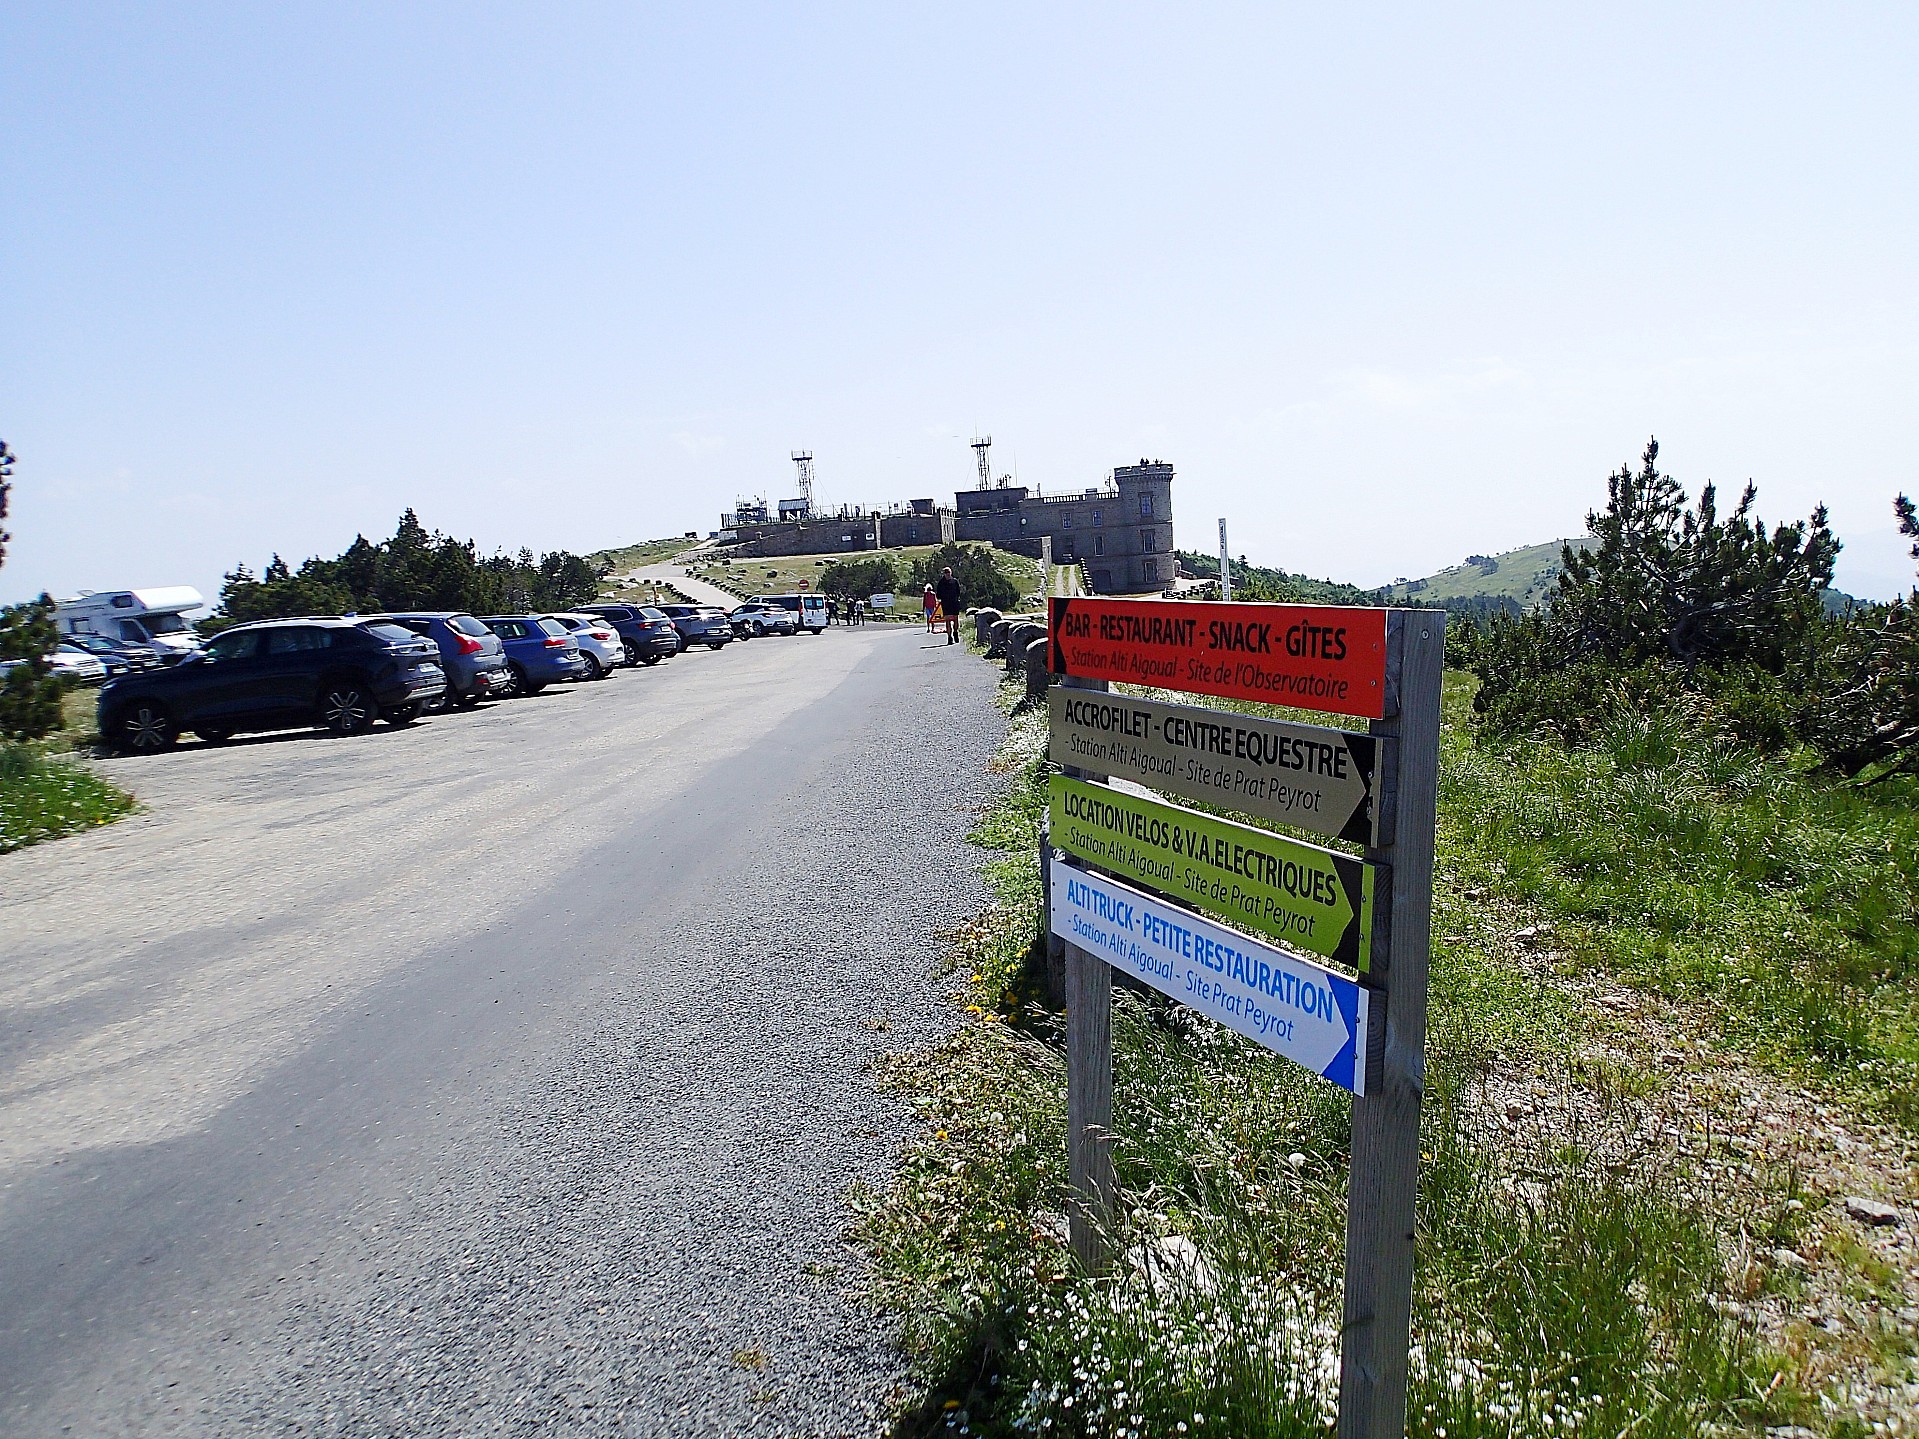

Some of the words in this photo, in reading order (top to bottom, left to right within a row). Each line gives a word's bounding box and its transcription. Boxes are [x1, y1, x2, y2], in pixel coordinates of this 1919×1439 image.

[1066, 613, 1090, 638] BAR
[1101, 615, 1196, 647] RESTAURANT
[1209, 620, 1271, 654] SNACK
[1286, 619, 1346, 660] GÎTES
[1071, 647, 1107, 668] Station
[1109, 651, 1128, 672] Alti
[1129, 652, 1177, 680] Aigoual
[1187, 658, 1211, 682] Site
[1214, 661, 1232, 685] de
[1065, 699, 1151, 739] ACCROFILET
[1163, 716, 1232, 756] CENTRE
[1235, 728, 1347, 780] EQUESTRE
[1071, 733, 1106, 759] Station
[1108, 742, 1127, 765] Alti
[1129, 747, 1176, 776] Aigoual
[1186, 759, 1211, 785] Site
[1213, 765, 1231, 790] de
[1234, 770, 1265, 799] Prat
[1268, 778, 1322, 812] Peyrot
[1064, 791, 1123, 834] LOCATION
[1126, 810, 1169, 849] VELOS
[1172, 826, 1183, 855] &
[1070, 826, 1105, 856] Station
[1107, 840, 1126, 863] Alti
[1128, 848, 1174, 882] Aigoual
[1184, 868, 1208, 896] Site
[1210, 878, 1228, 903] de
[1231, 885, 1261, 916] Prat
[1264, 897, 1315, 937] Peyrot
[1073, 914, 1106, 947] Station
[1108, 933, 1127, 957] Alti
[1128, 943, 1174, 980] Aigoual
[1185, 970, 1209, 1000] Site
[1213, 983, 1241, 1016] Prat
[1244, 998, 1294, 1041] Peyrot
[1143, 912, 1191, 958] PETITE
[1195, 934, 1333, 1024] RESTAURATION
